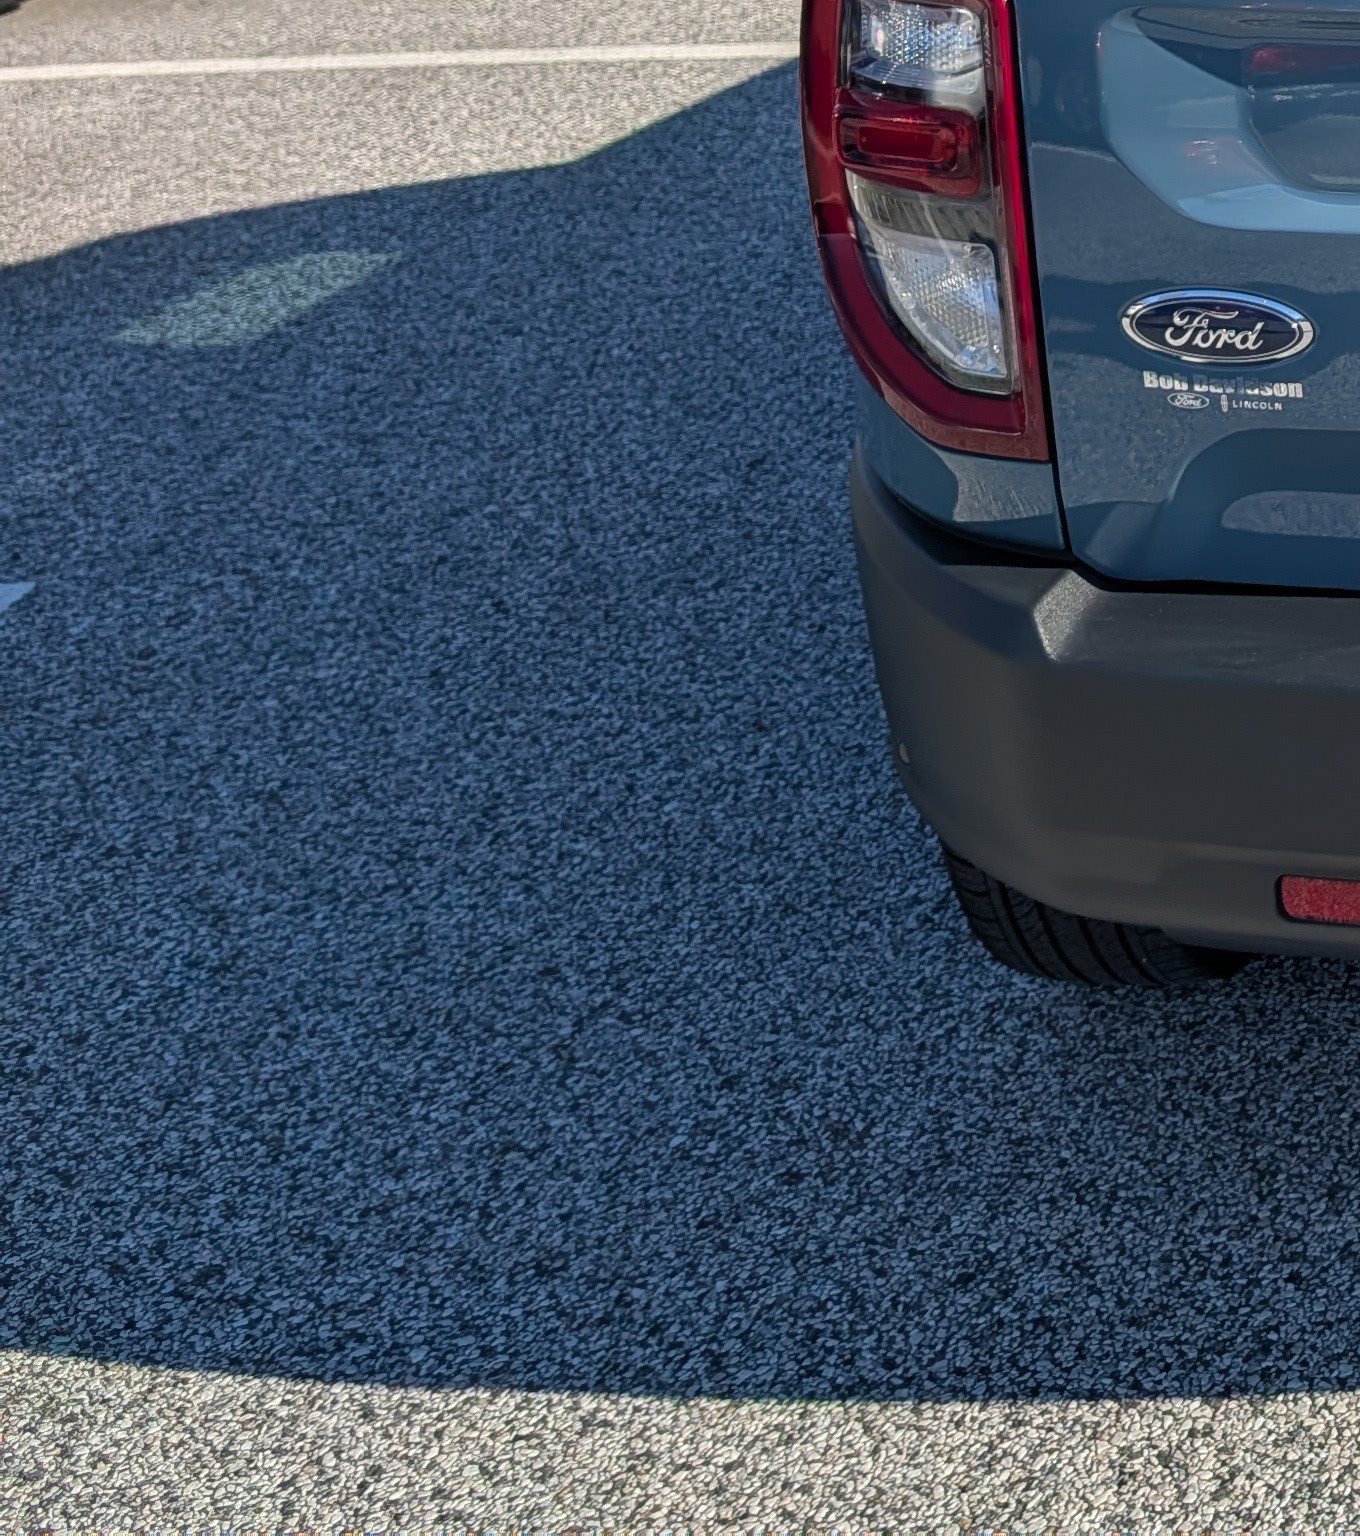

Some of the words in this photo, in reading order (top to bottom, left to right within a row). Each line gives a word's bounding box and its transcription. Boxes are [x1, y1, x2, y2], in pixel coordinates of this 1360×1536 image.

[1164, 308, 1265, 351] Ford
[1142, 370, 1188, 391] Bob
[1193, 373, 1303, 399] Davidson
[1174, 394, 1204, 409] Ford
[1232, 399, 1283, 411] LINCOLN
